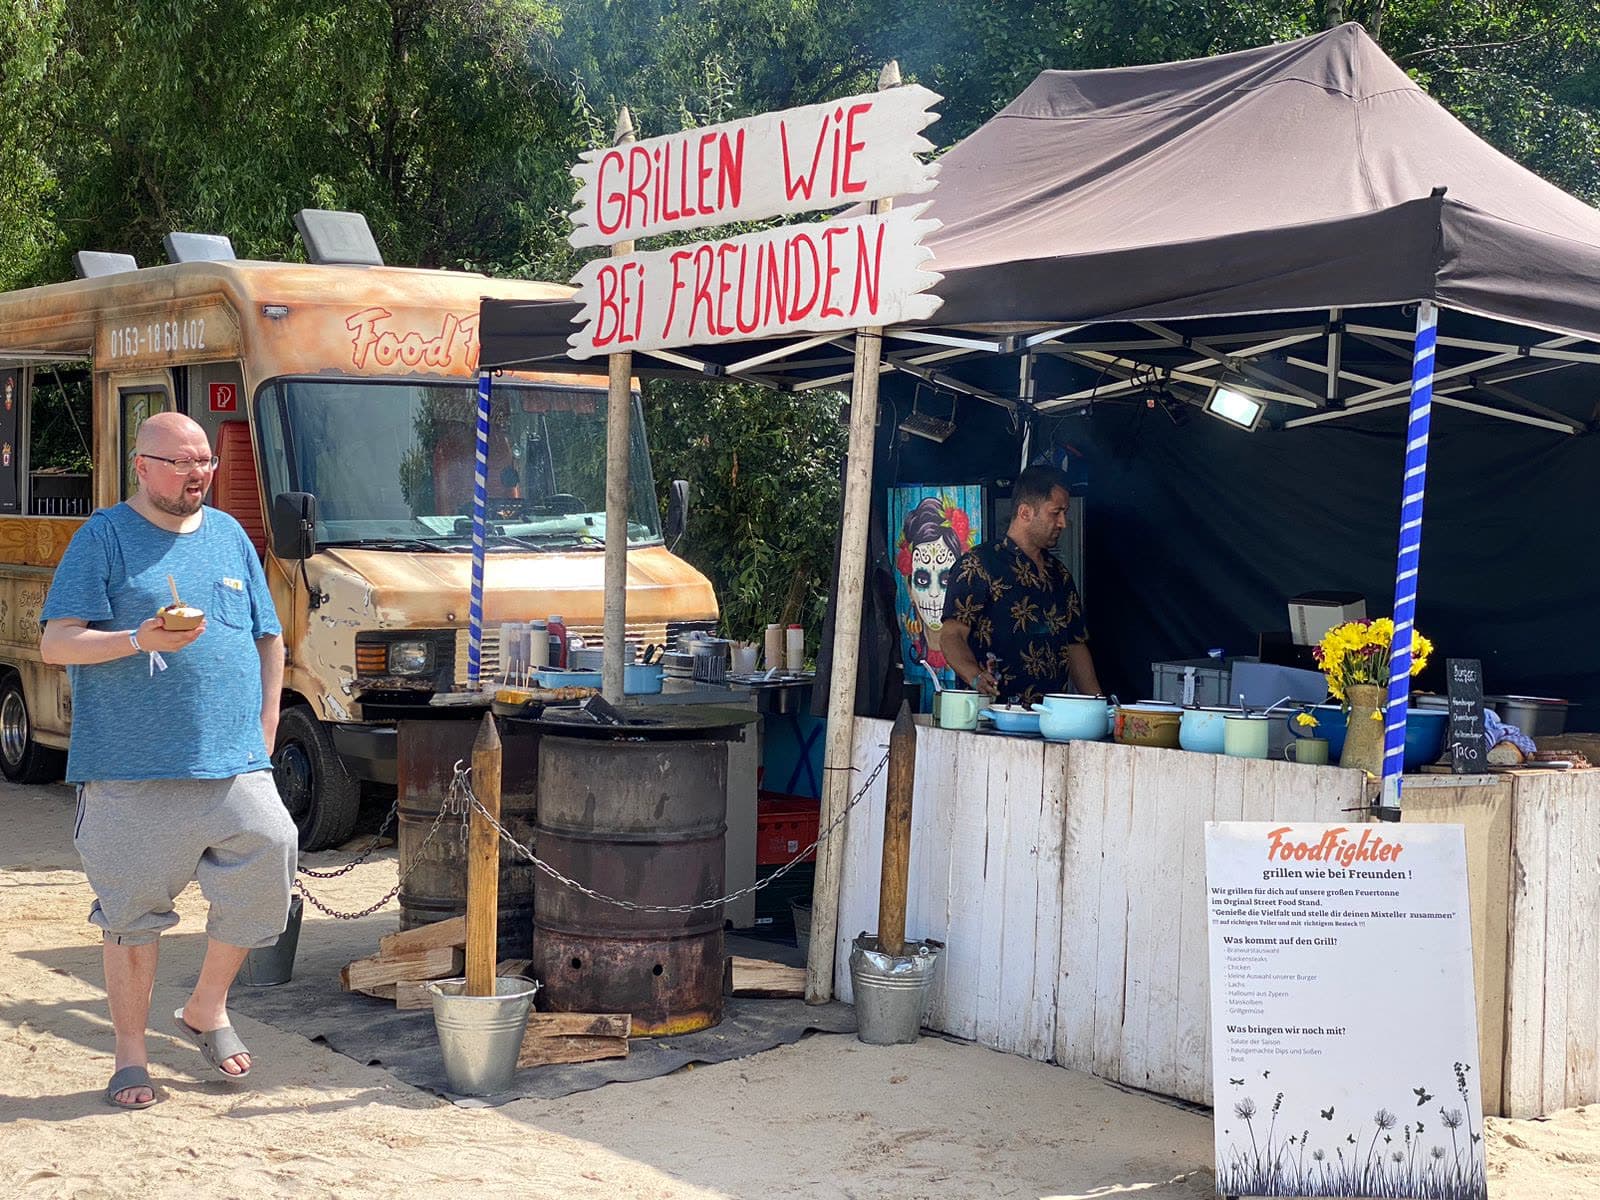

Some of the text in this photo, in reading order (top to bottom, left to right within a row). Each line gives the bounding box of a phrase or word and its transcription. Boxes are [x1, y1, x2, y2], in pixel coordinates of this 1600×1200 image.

[662, 223, 886, 338] FREUNDEN
[1452, 742, 1478, 760] Taco
[1267, 826, 1404, 868] FoodFighter
[1263, 868, 1303, 881] grillen
[1305, 868, 1326, 879] wie
[1328, 869, 1346, 879] bei
[1349, 869, 1406, 880] Freunden
[1211, 887, 1226, 895] Wir
[1227, 887, 1253, 897] grillen
[1267, 888, 1285, 896] dich
[1285, 888, 1298, 896] auf
[1326, 889, 1354, 898] großen
[1355, 889, 1400, 897] Feuertonne
[1223, 898, 1252, 907] Orginal
[1253, 898, 1276, 906] Street
[1278, 898, 1296, 906] Food
[1297, 899, 1323, 907] Stand.
[1261, 909, 1290, 917] Vielfalt
[1330, 910, 1341, 918] dir
[1342, 910, 1370, 918] deinen
[1371, 911, 1406, 919] Mixteller
[1223, 936, 1338, 946] Was kommt auf den Grill?
[1226, 1025, 1346, 1035] Was bringen wir noch mit?
